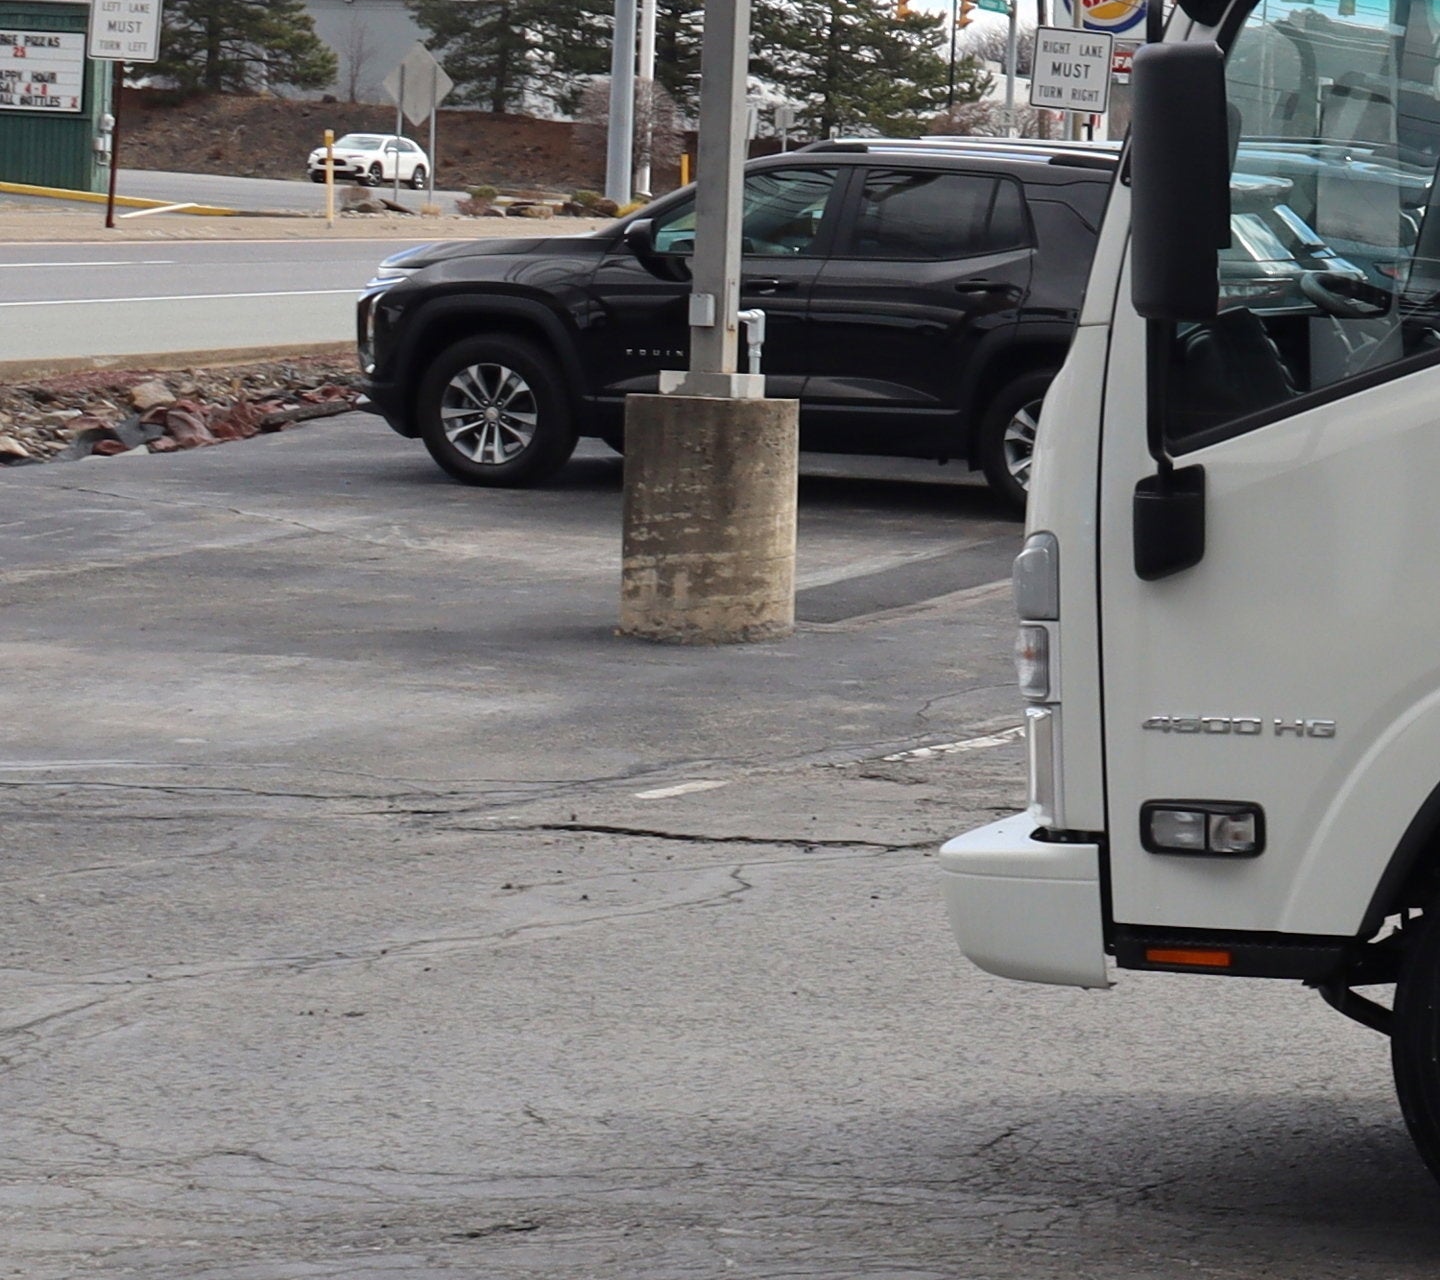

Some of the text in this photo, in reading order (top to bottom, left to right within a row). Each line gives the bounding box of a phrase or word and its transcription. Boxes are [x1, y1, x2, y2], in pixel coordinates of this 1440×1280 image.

[102, 1, 151, 14] LEFT LANE
[107, 20, 143, 34] MUST
[99, 40, 148, 53] TURN LEFT
[1042, 40, 1103, 58] RIGHT LANE
[1051, 61, 1091, 79] MUST
[1039, 85, 1099, 102] TURN RIGHT
[1142, 716, 1336, 738] 4500 HG
